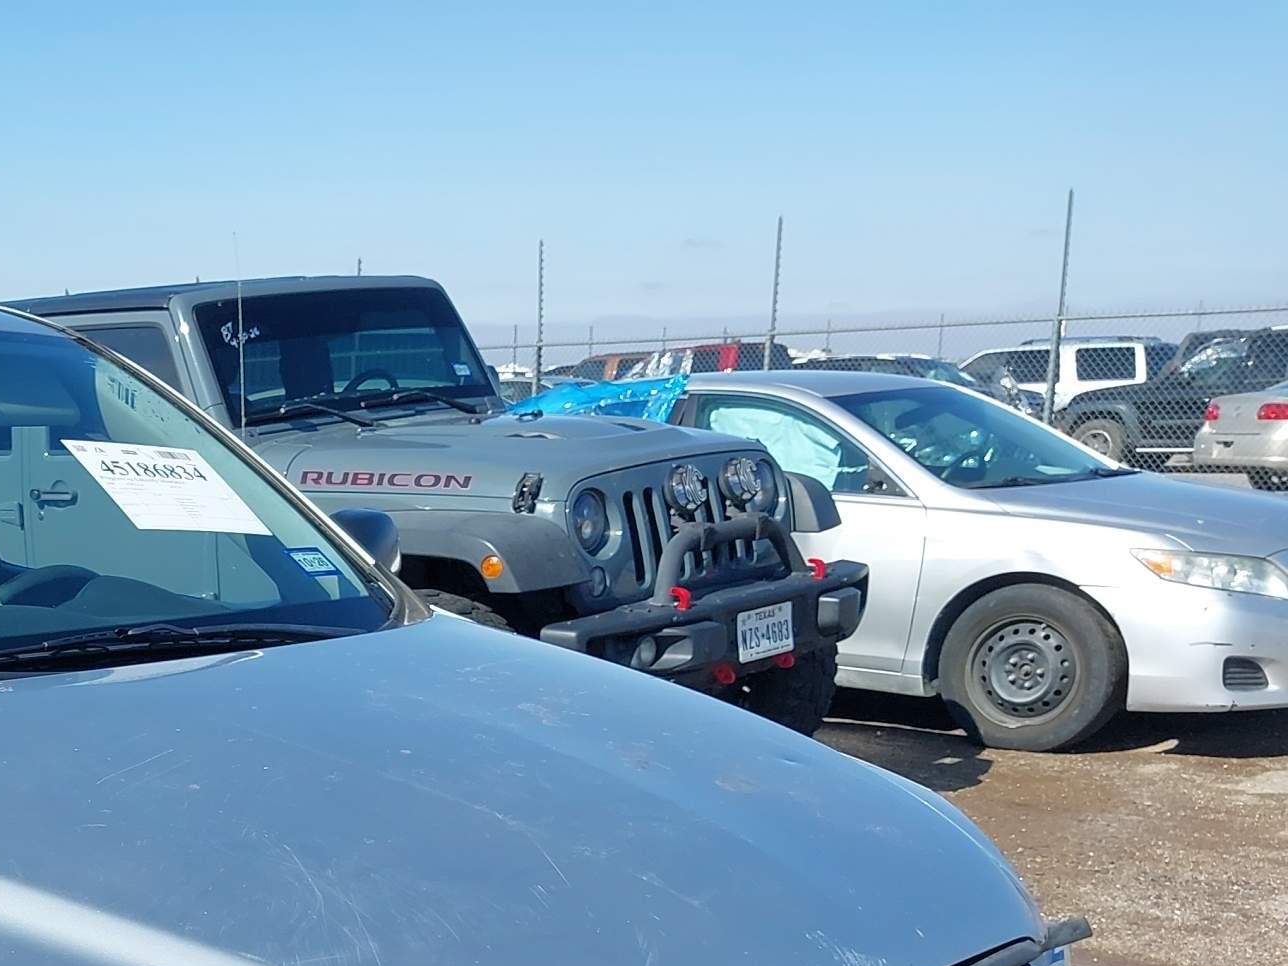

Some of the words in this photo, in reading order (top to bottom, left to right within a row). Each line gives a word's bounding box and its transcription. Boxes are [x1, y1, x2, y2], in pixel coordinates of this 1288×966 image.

[100, 460, 208, 481] 45186834
[299, 470, 473, 489] RUBICON
[754, 609, 776, 620] TEXAS
